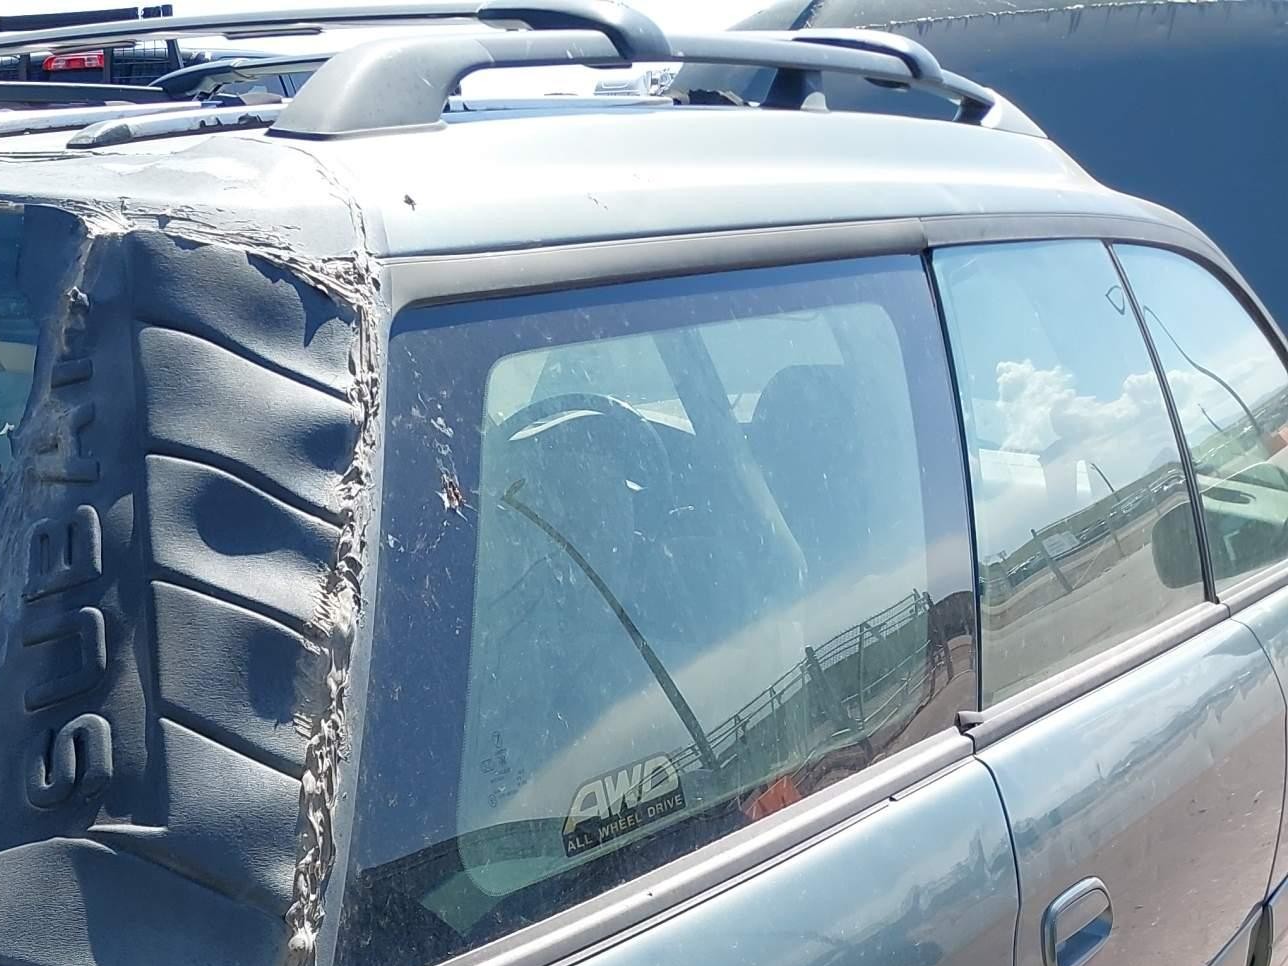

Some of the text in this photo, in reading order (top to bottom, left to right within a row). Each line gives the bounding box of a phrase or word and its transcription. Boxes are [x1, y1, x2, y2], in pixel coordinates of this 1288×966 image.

[565, 755, 679, 834] AWD
[567, 794, 683, 852] ALL WHEEL DRIVE
